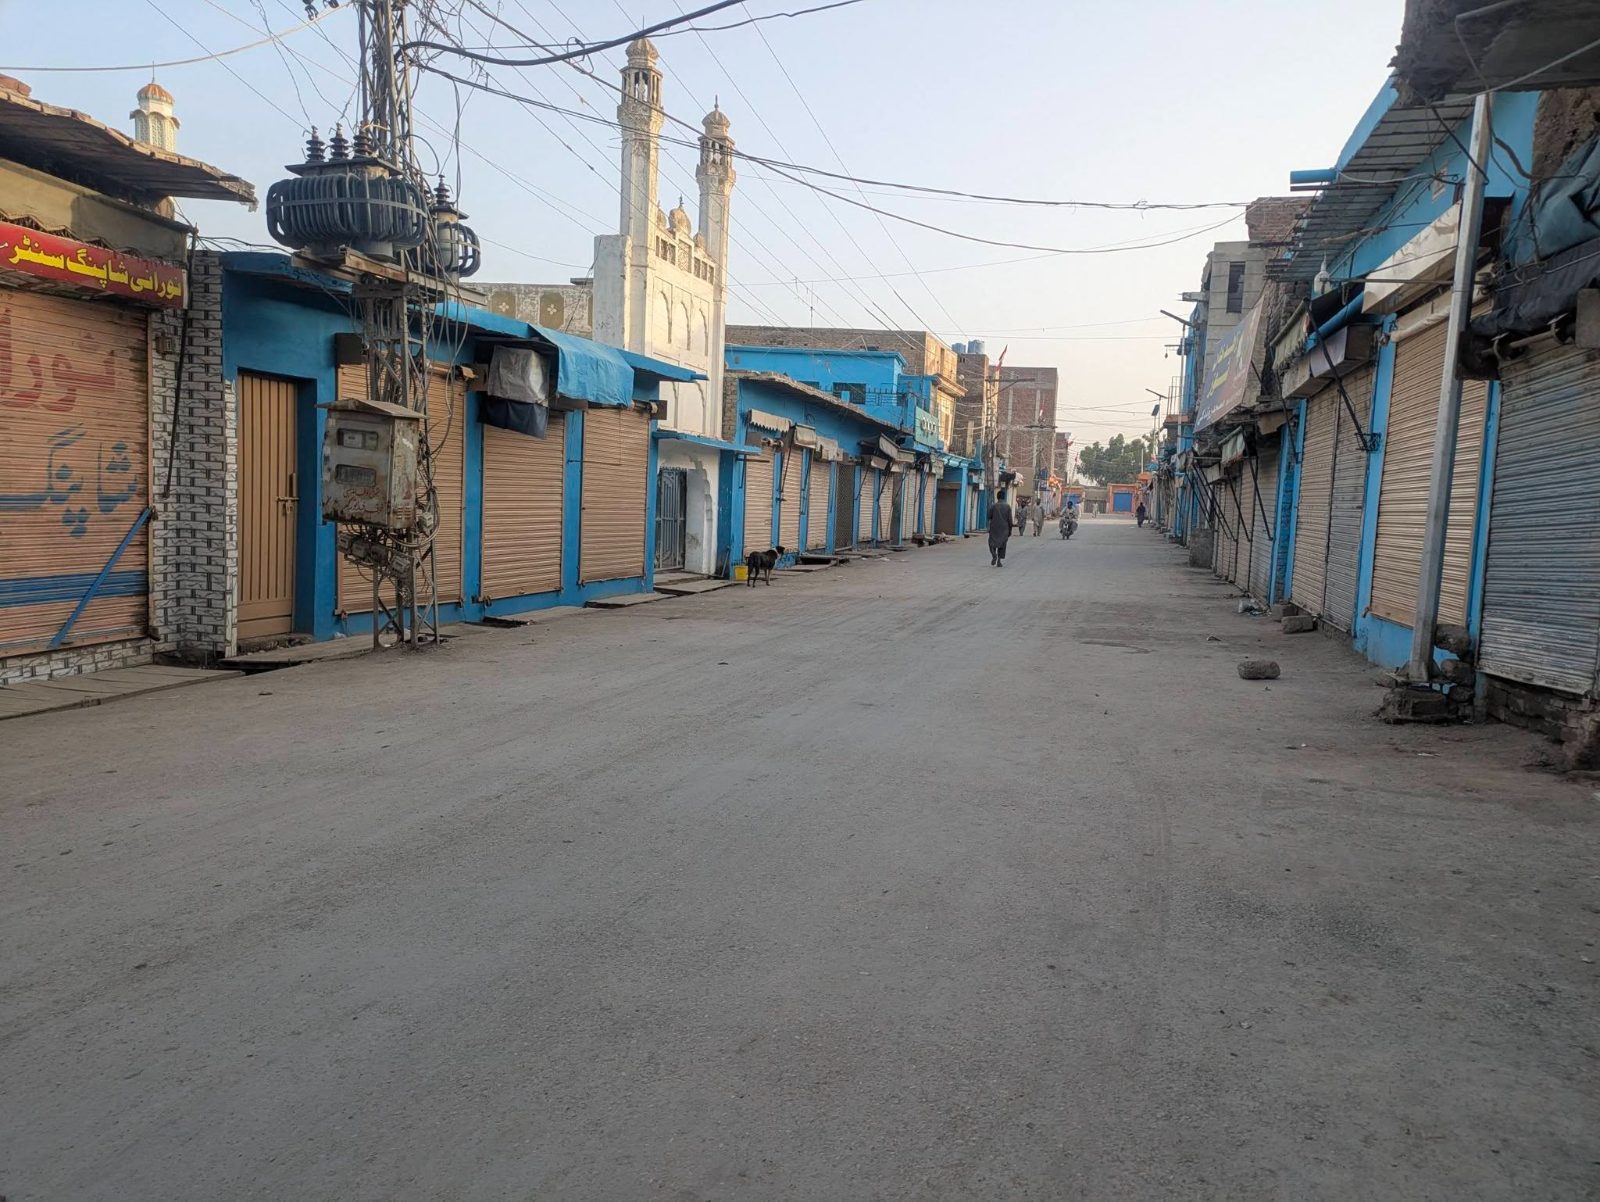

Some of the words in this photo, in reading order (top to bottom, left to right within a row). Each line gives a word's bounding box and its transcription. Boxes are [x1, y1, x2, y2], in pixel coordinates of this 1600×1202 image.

[8, 234, 65, 269] سنٹر
[66, 248, 129, 288] شاپنگ
[130, 267, 182, 299] نورانی
[0, 308, 115, 412] نورا
